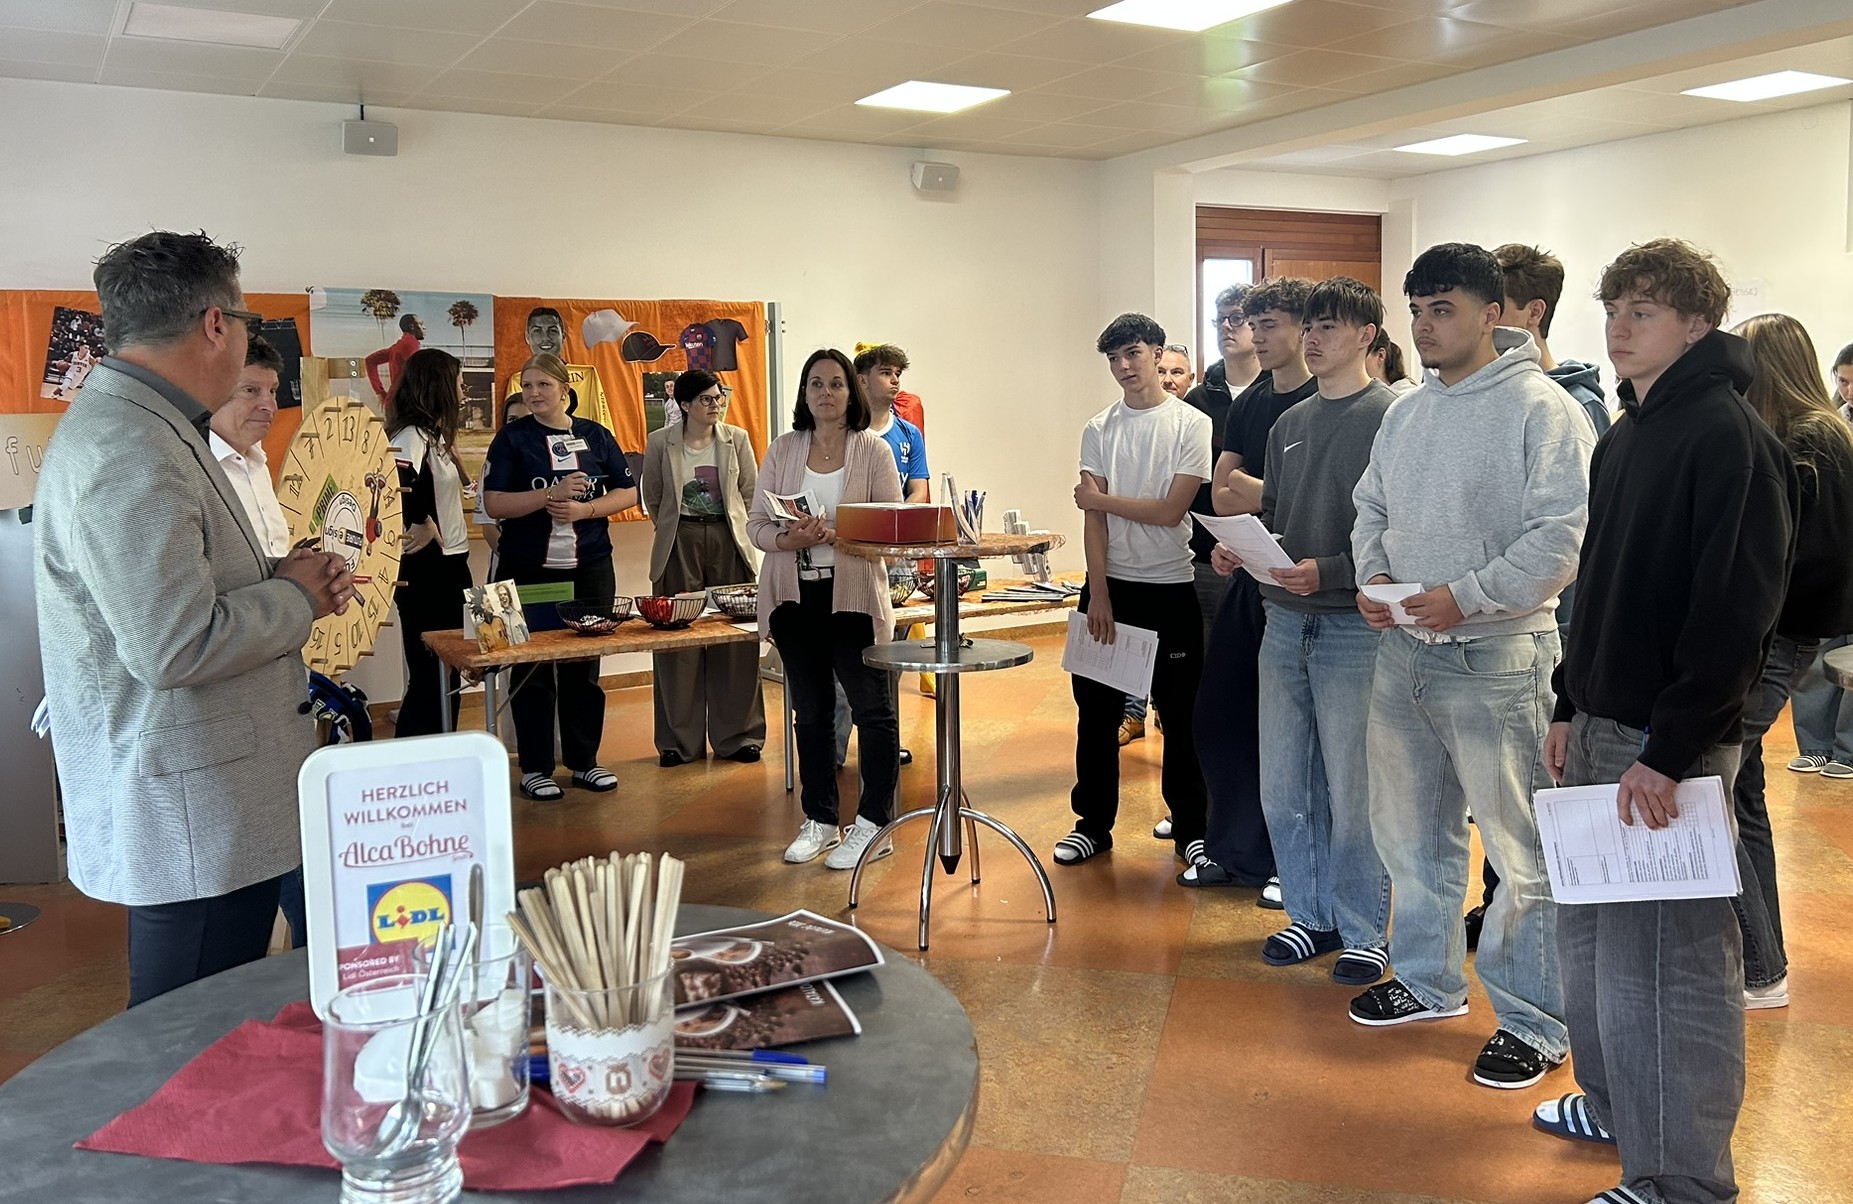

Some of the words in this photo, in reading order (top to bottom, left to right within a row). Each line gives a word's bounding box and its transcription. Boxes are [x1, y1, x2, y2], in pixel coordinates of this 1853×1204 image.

[323, 417, 334, 441] 2
[342, 415, 355, 442] 13
[361, 430, 370, 454] 8
[361, 780, 449, 802] HERZLICH
[344, 798, 467, 825] WILLKOMMEN
[339, 841, 394, 867] Alca
[394, 834, 469, 859] Bohne
[338, 957, 387, 970] PONSORED
